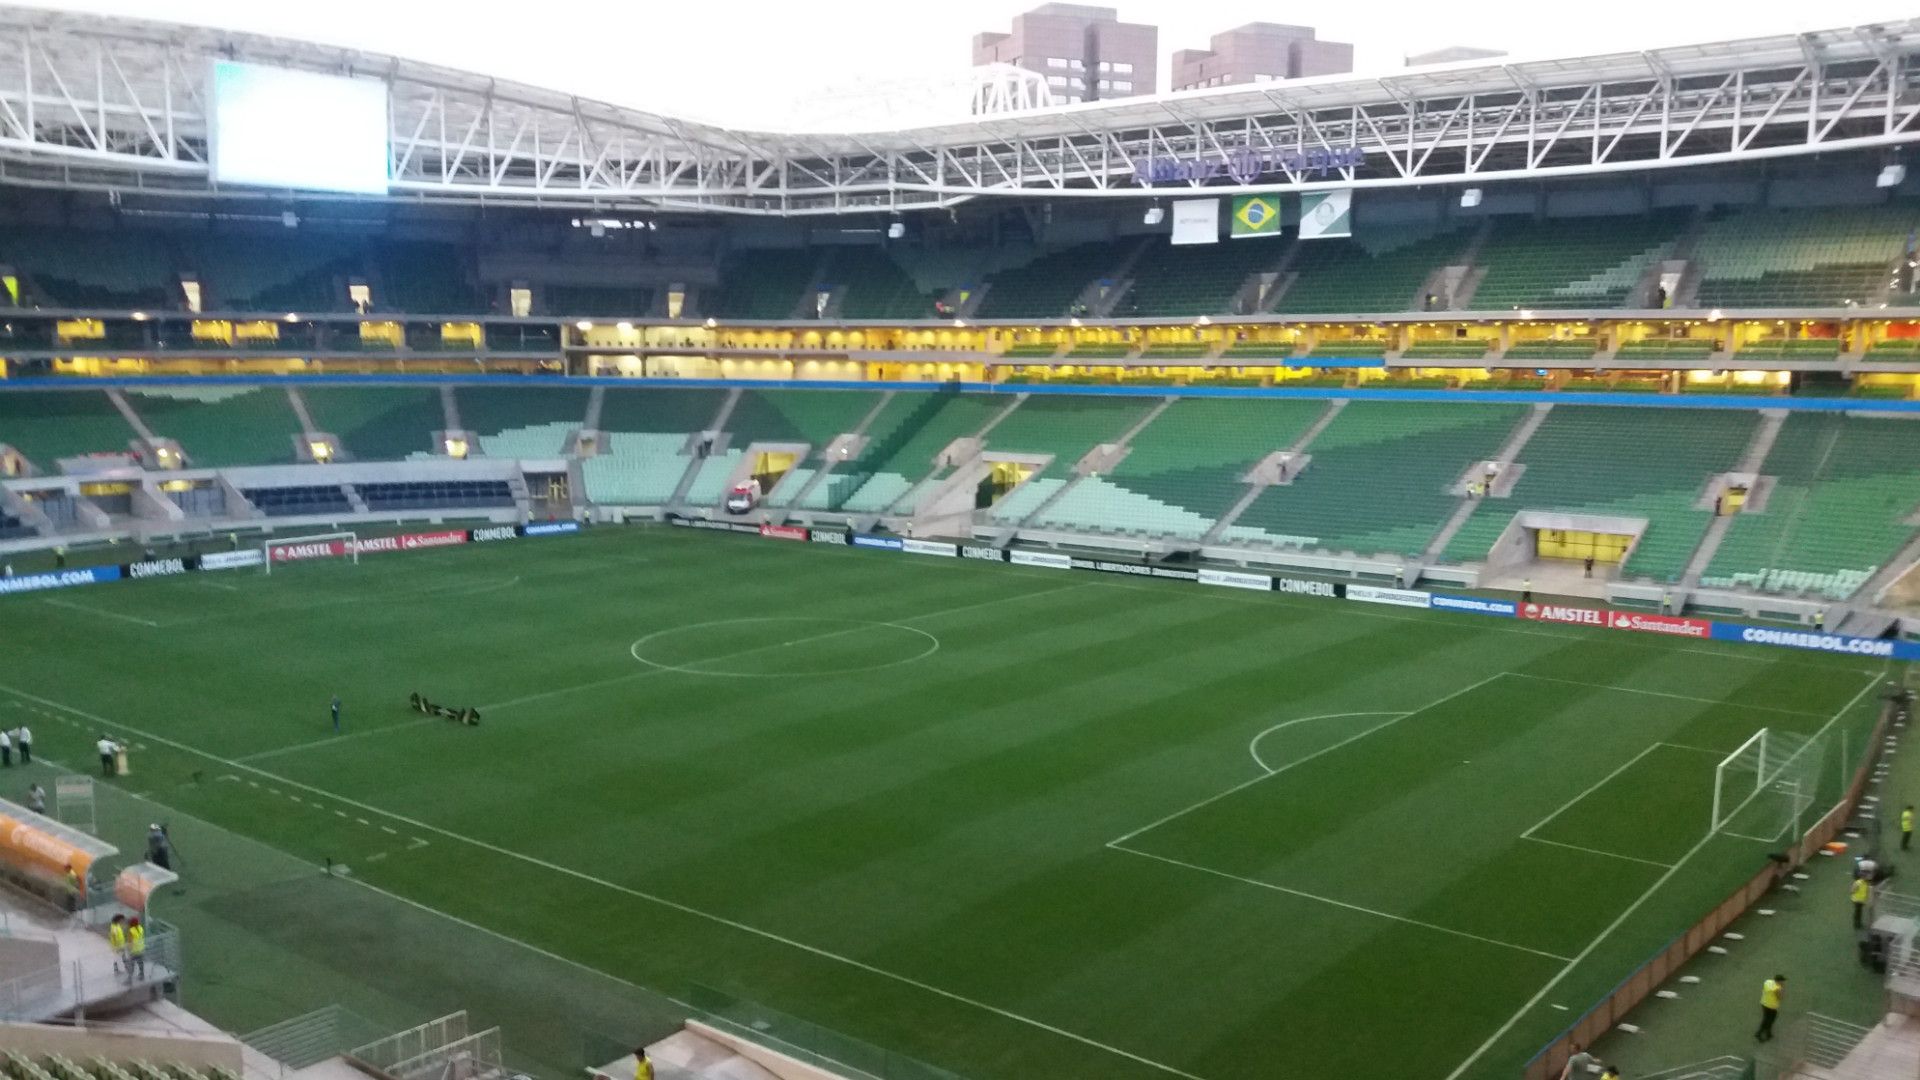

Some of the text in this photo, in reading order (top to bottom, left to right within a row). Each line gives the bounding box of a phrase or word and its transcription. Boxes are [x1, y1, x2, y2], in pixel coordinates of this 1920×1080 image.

[356, 531, 463, 552] AMSTEL Santander
[473, 526, 517, 542] CONMEBOL
[811, 530, 847, 545] CONMEBOL
[287, 542, 333, 559] AMSTEL
[962, 546, 1005, 561] CONMEBOL
[129, 557, 186, 579] CONMEBOL
[1279, 578, 1337, 598] CONMEBOL
[1540, 605, 1705, 636] AMSTEL Santander
[1742, 627, 1893, 656] CONMEBOL.COM
